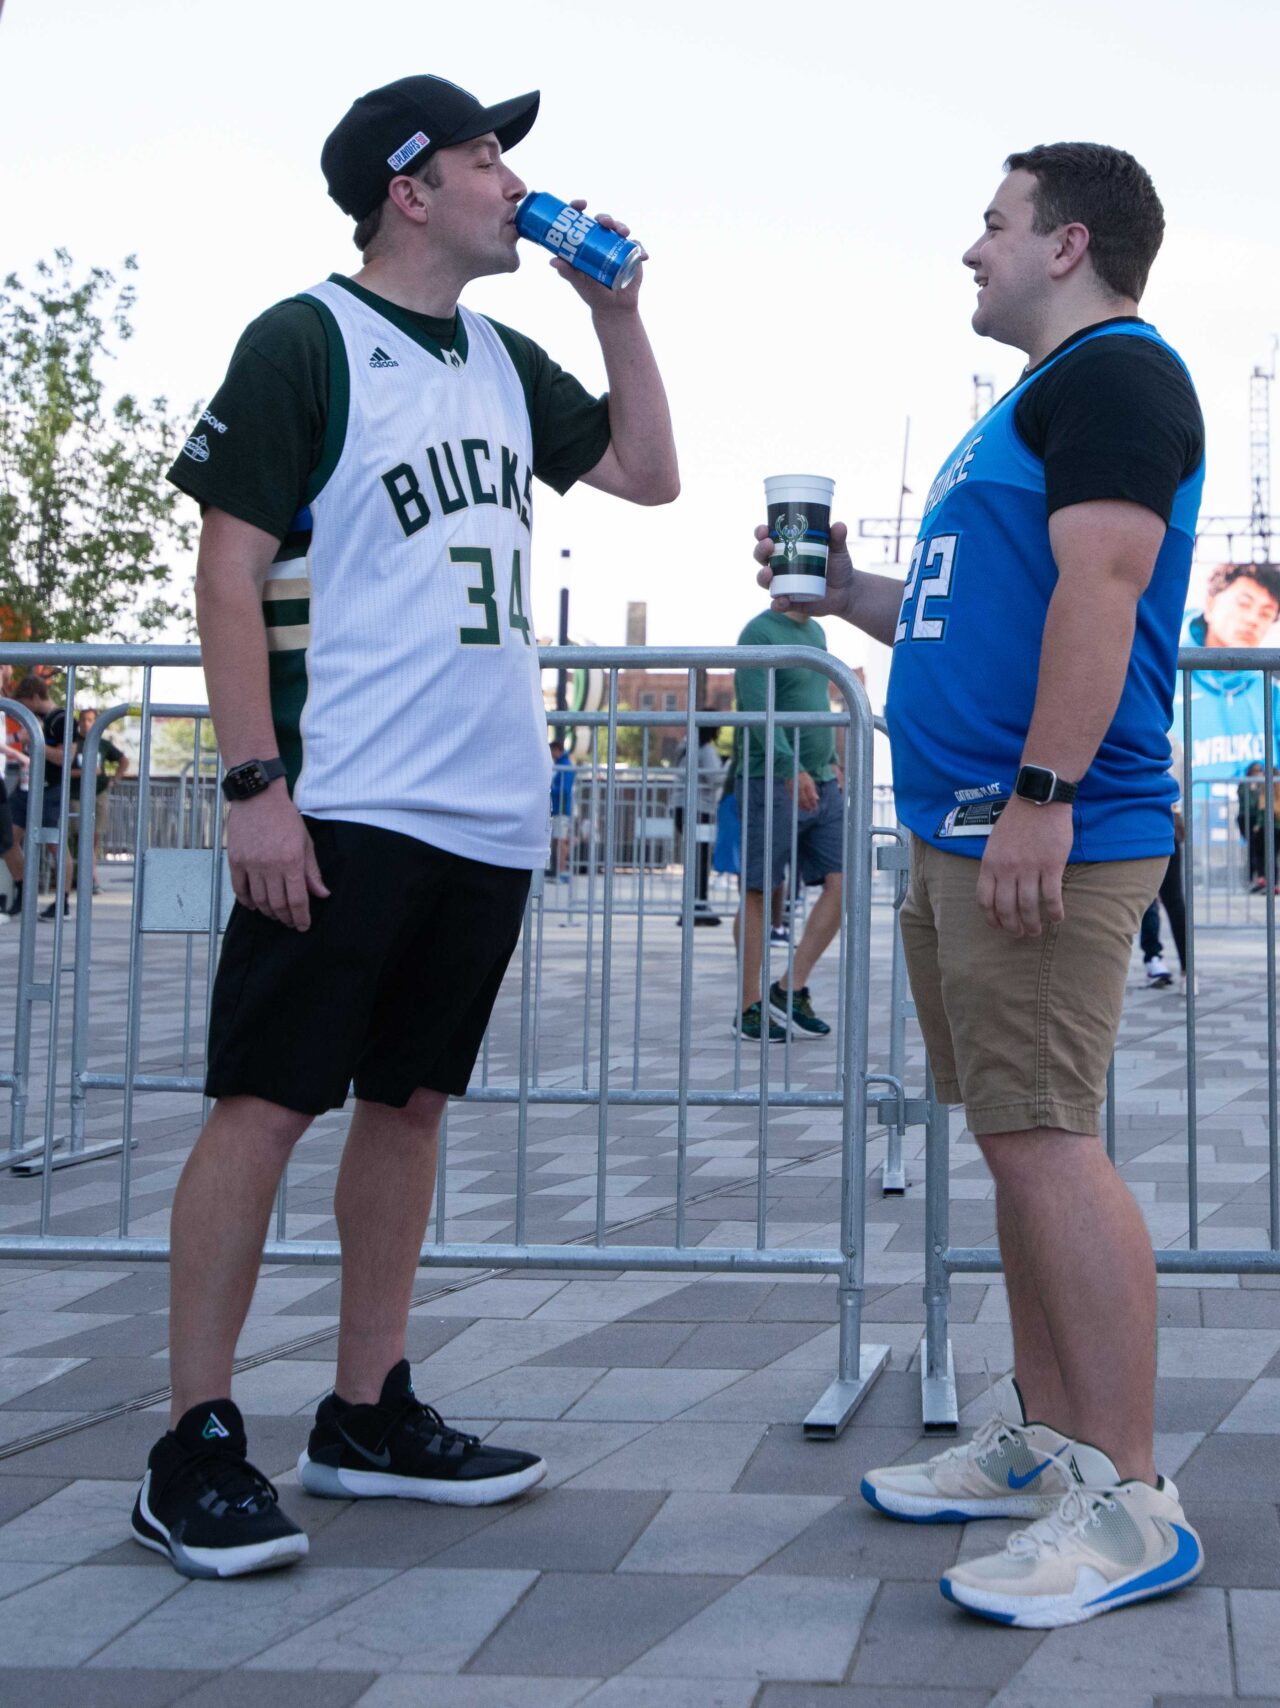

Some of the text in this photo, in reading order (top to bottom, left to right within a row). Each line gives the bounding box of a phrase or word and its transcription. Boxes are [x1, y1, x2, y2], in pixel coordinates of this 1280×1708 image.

[545, 207, 580, 247] BUD
[369, 360, 399, 369] adidas
[448, 546, 531, 646] 34
[894, 533, 960, 643] 22
